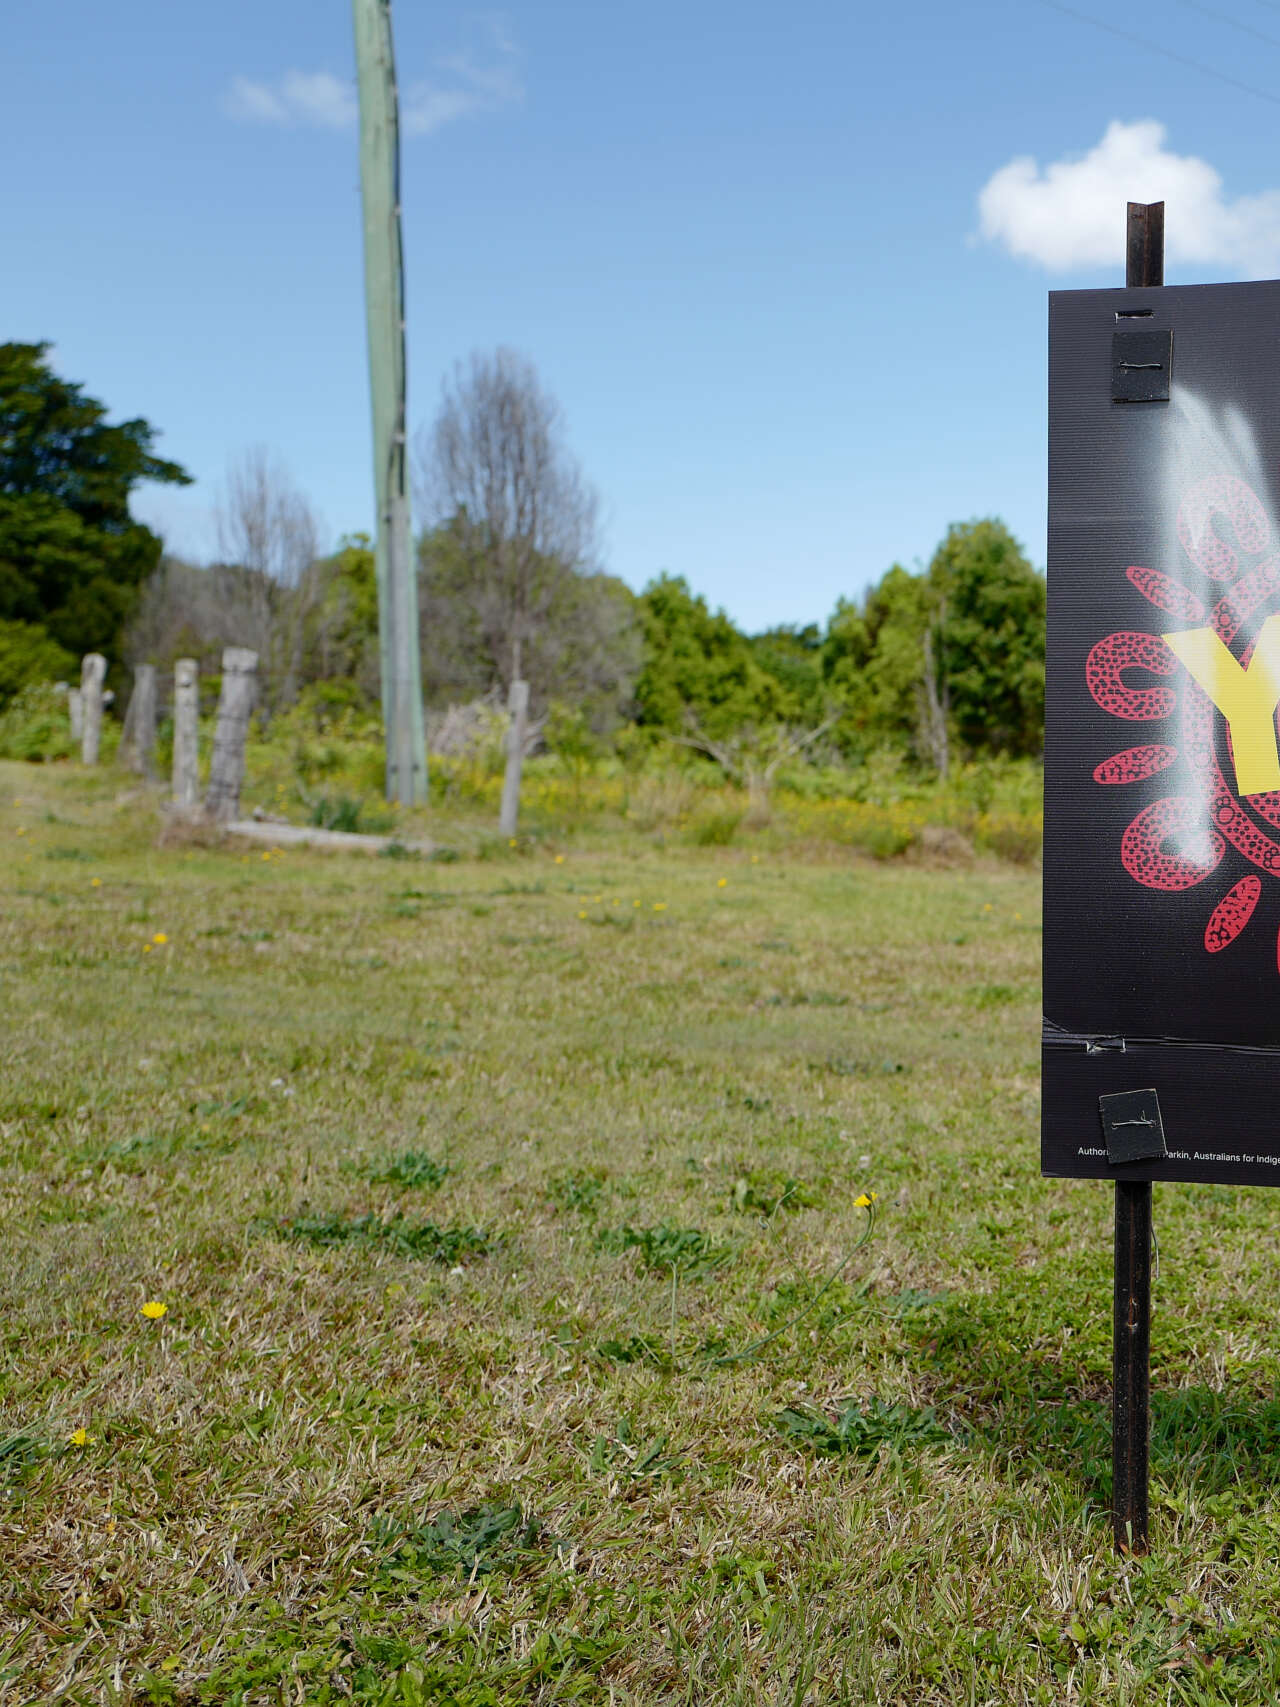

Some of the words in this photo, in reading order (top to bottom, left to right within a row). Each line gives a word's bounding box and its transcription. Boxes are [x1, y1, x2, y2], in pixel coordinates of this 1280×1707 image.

[1077, 1146, 1109, 1156] Authori
[1193, 1151, 1241, 1162] Australians
[1242, 1154, 1255, 1162] for
